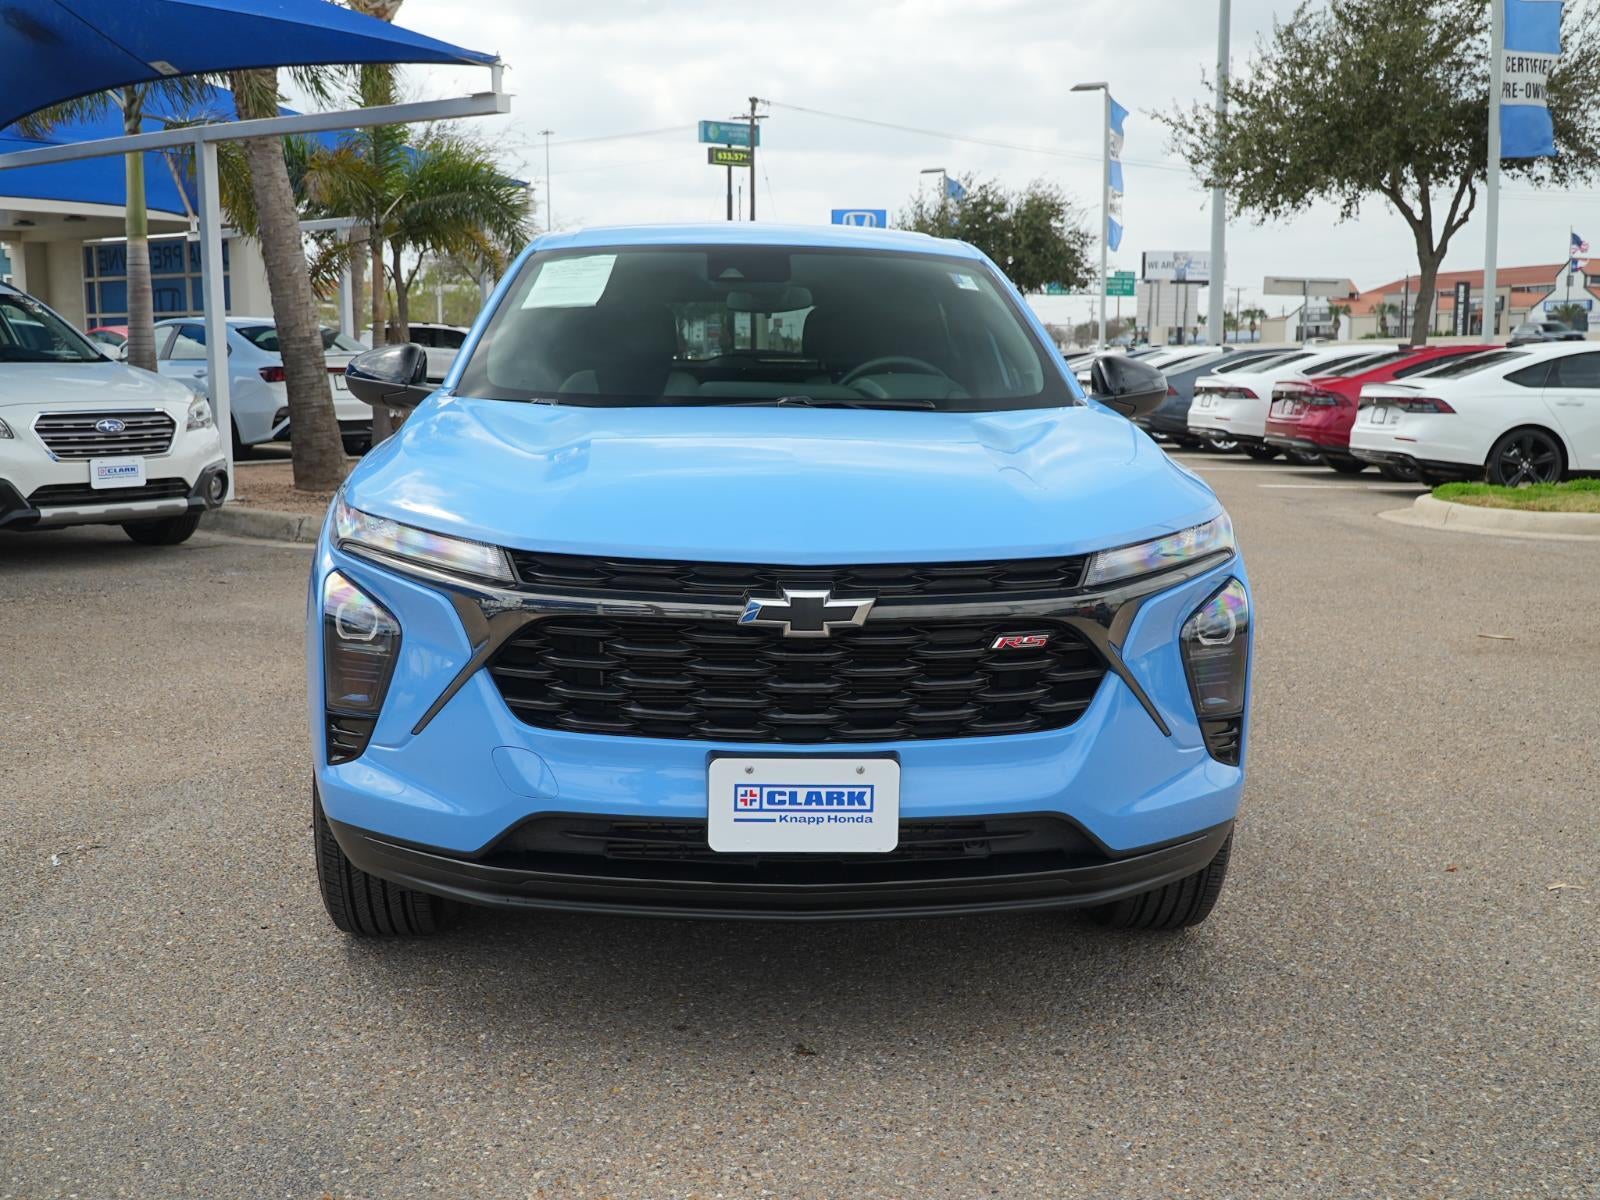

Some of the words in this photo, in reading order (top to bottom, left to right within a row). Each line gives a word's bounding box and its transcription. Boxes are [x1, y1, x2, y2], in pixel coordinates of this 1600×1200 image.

[992, 634, 1049, 649] RS
[766, 790, 867, 807] CLARK
[779, 814, 825, 825] Knapp
[827, 814, 873, 823] Honda
